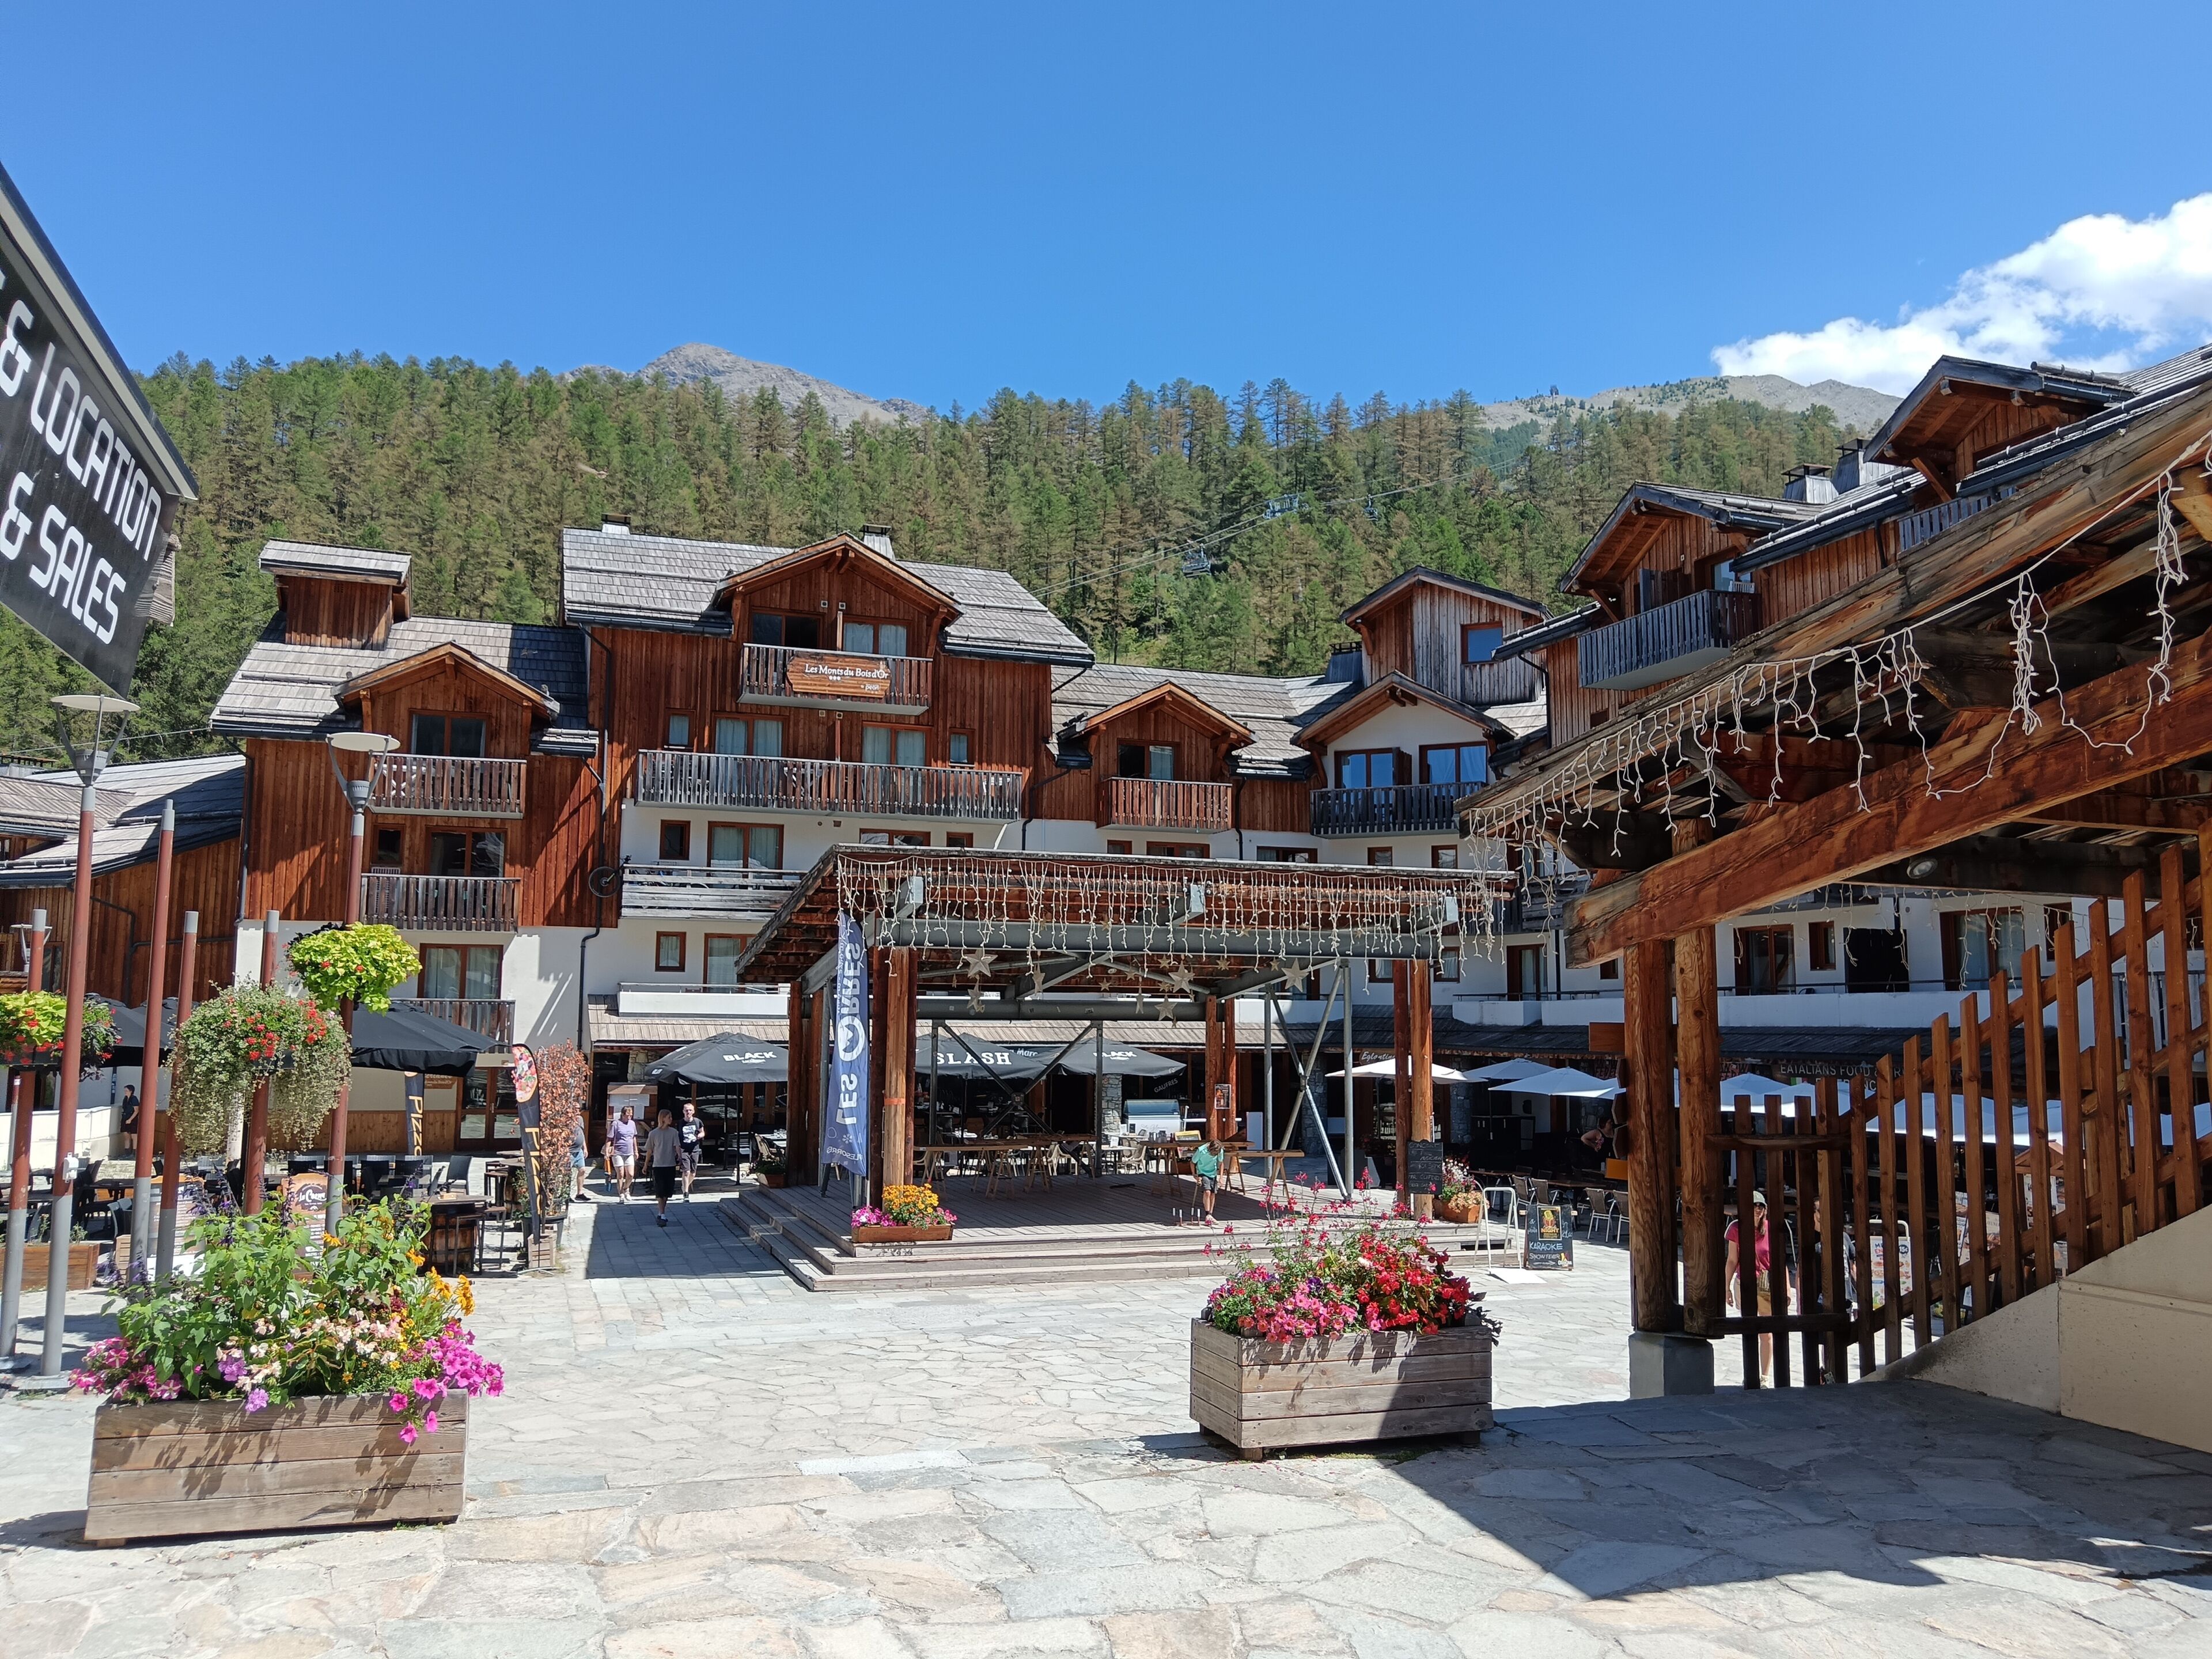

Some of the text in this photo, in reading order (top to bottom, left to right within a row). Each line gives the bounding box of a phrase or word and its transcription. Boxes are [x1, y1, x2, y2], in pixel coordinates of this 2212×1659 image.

[0, 300, 162, 562] & LOCATION
[0, 472, 126, 645] & SALES
[805, 664, 889, 679] Les Monts du Bois d'Or
[722, 1051, 777, 1062] BLACK
[936, 1052, 1012, 1065] SLASH
[1154, 1078, 1179, 1093] GAUFRES
[1529, 1241, 1563, 1251] KARAOKE
